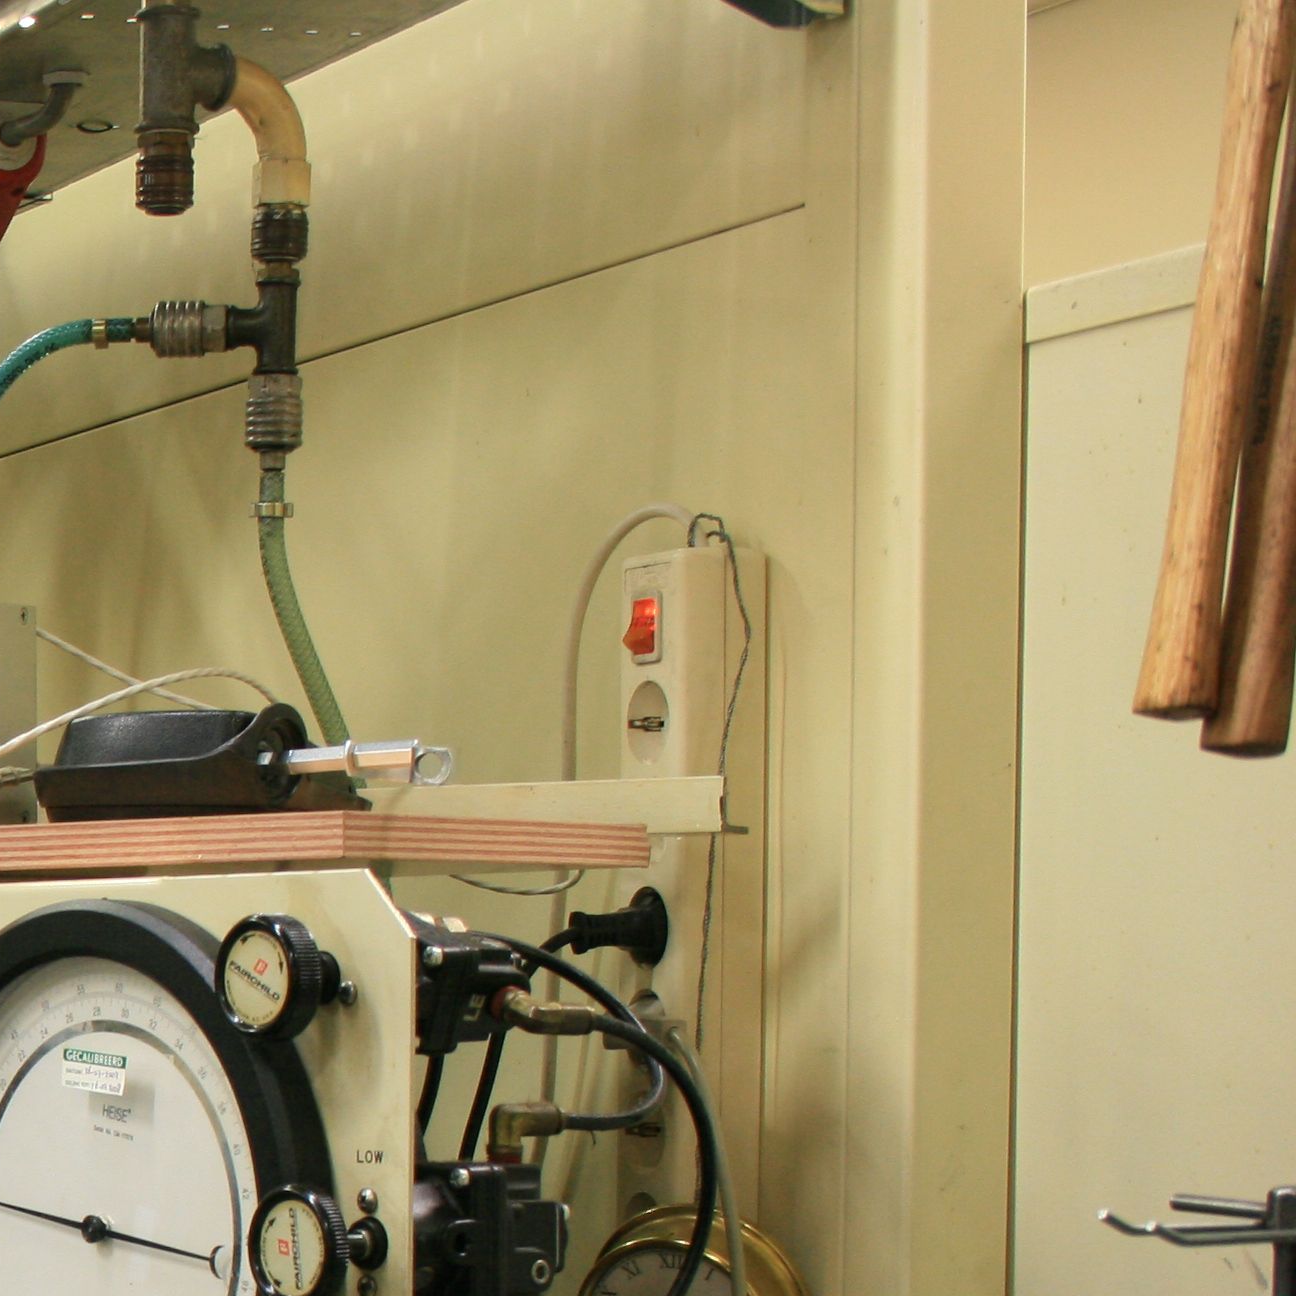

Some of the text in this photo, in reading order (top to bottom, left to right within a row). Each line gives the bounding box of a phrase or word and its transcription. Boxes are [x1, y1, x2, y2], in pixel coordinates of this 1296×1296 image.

[229, 959, 281, 1002] FAIRCHILD
[65, 1049, 124, 1068] GECALIBREERD
[357, 1150, 383, 1164] LOW
